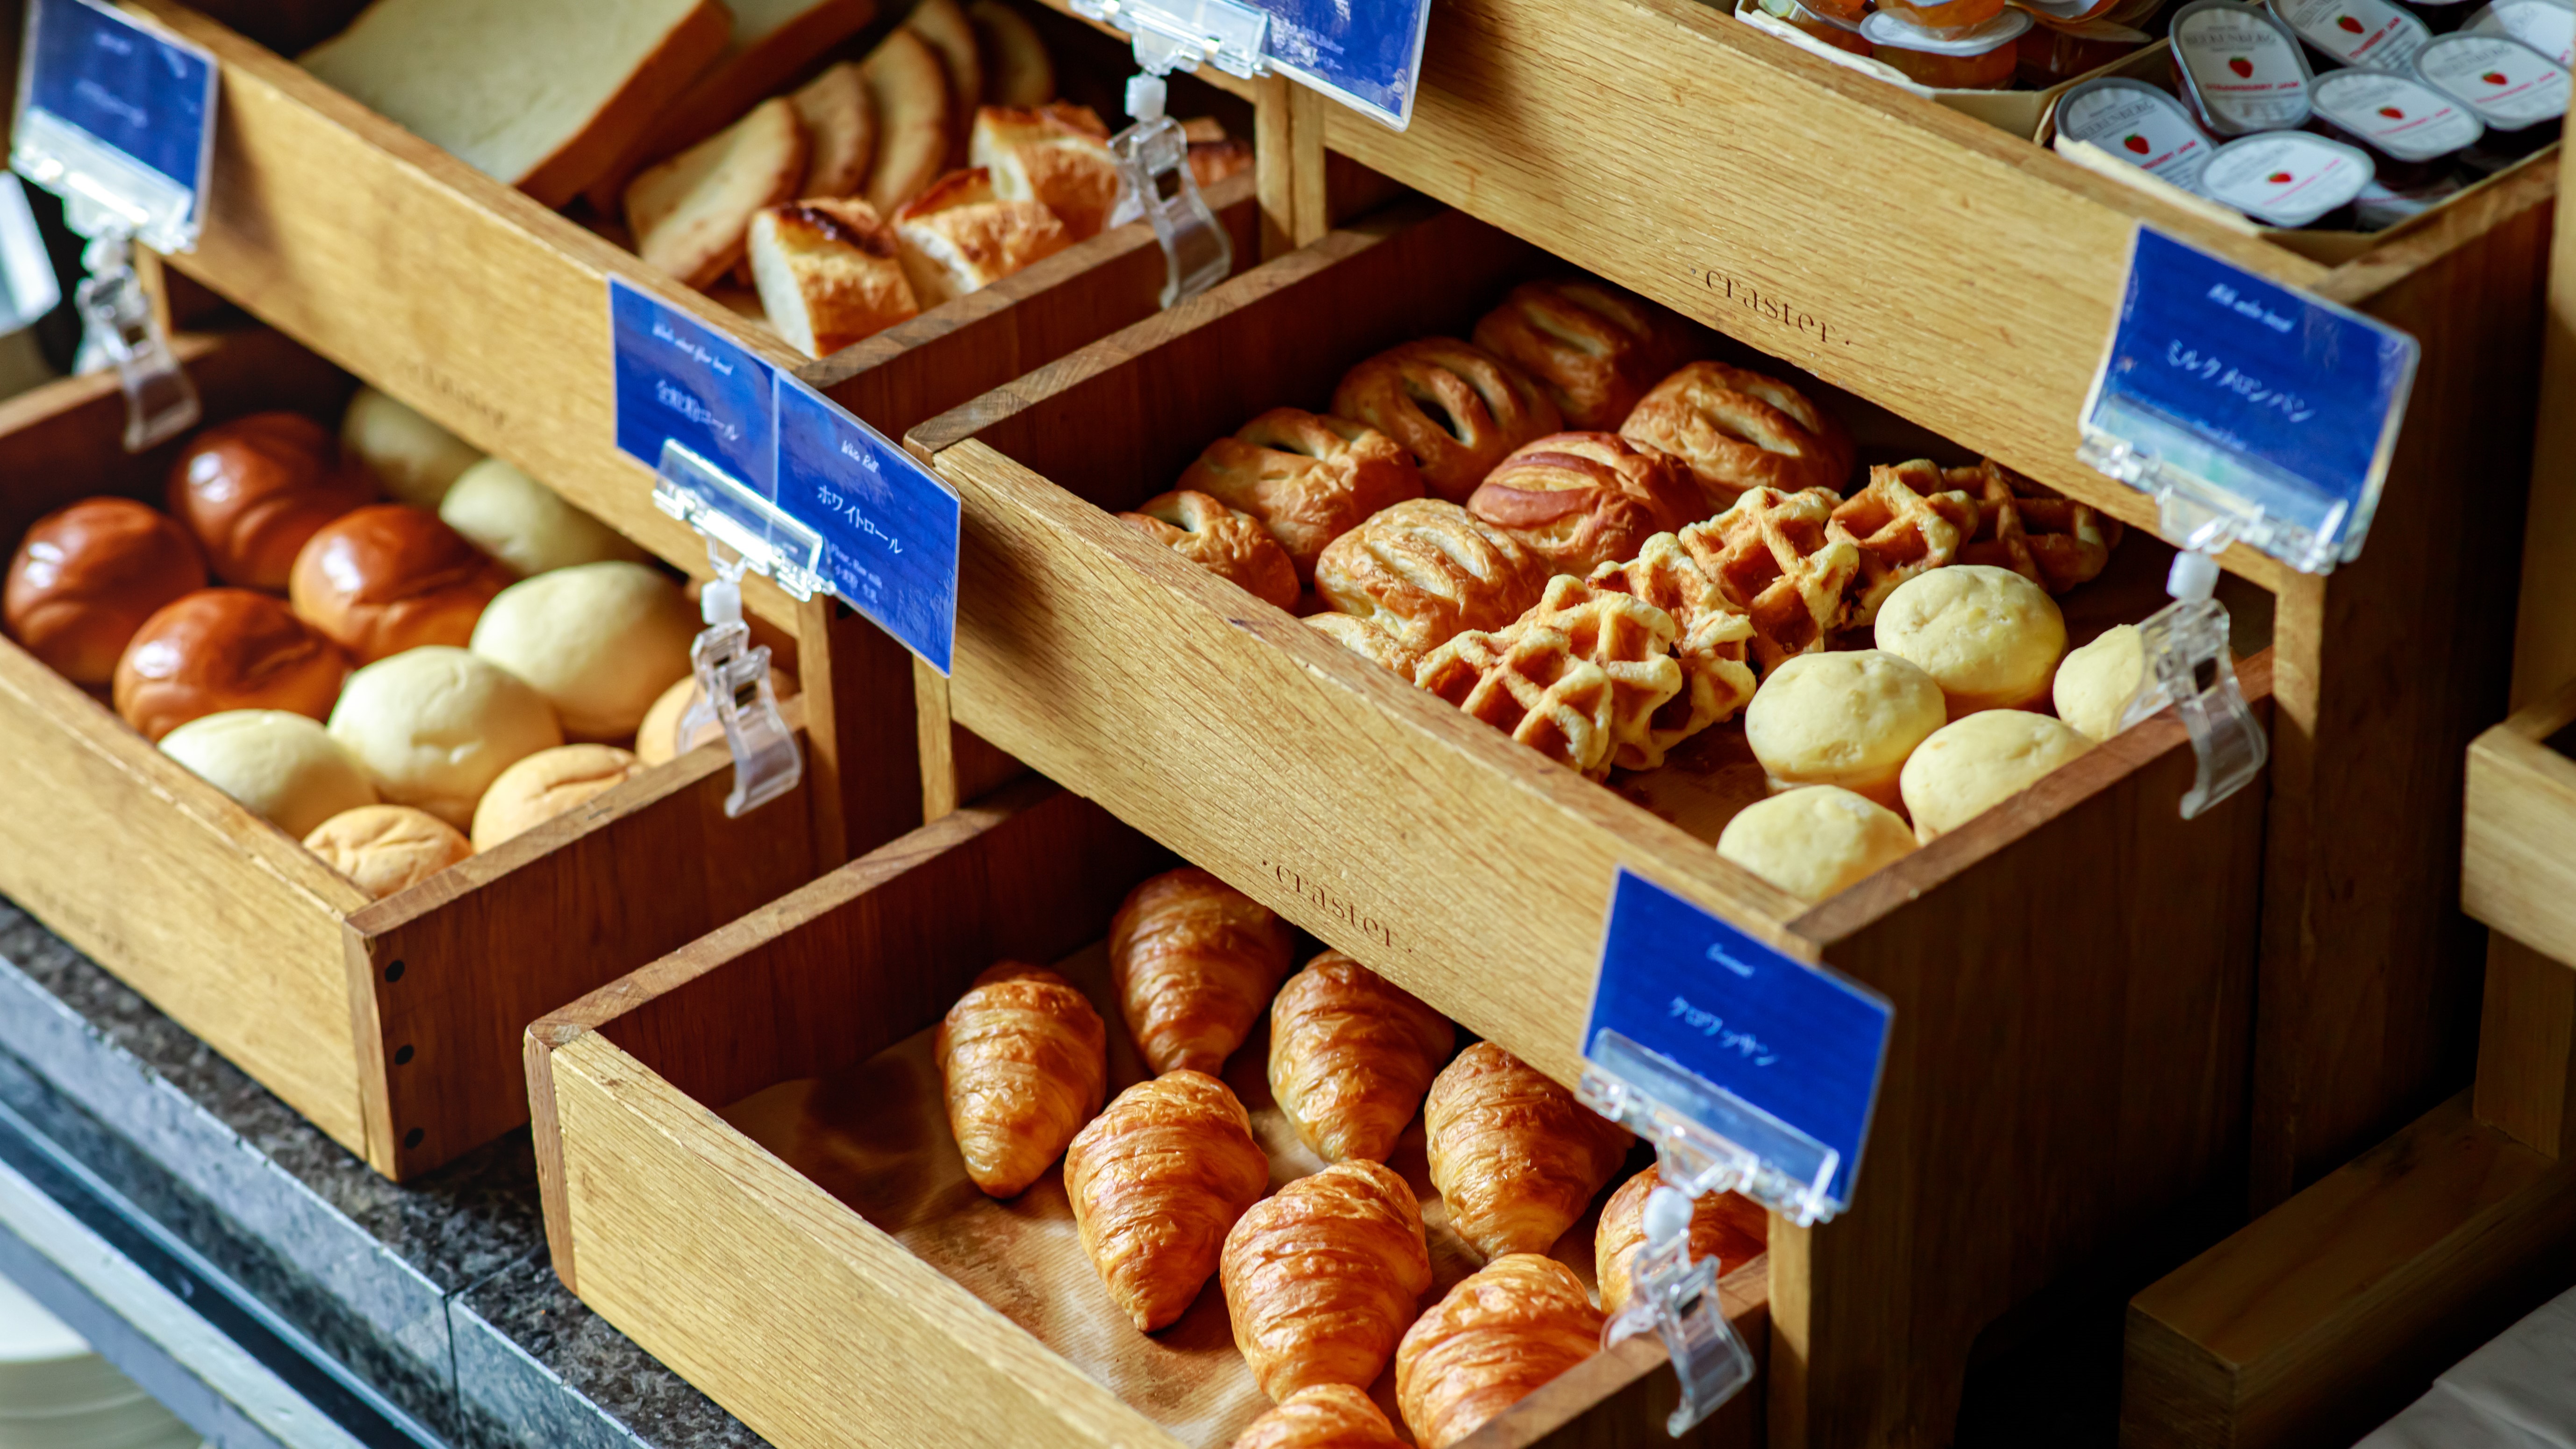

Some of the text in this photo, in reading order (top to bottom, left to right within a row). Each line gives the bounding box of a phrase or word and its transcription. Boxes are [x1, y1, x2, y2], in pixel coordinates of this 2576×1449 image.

[817, 485, 903, 555] ホワイトロール
